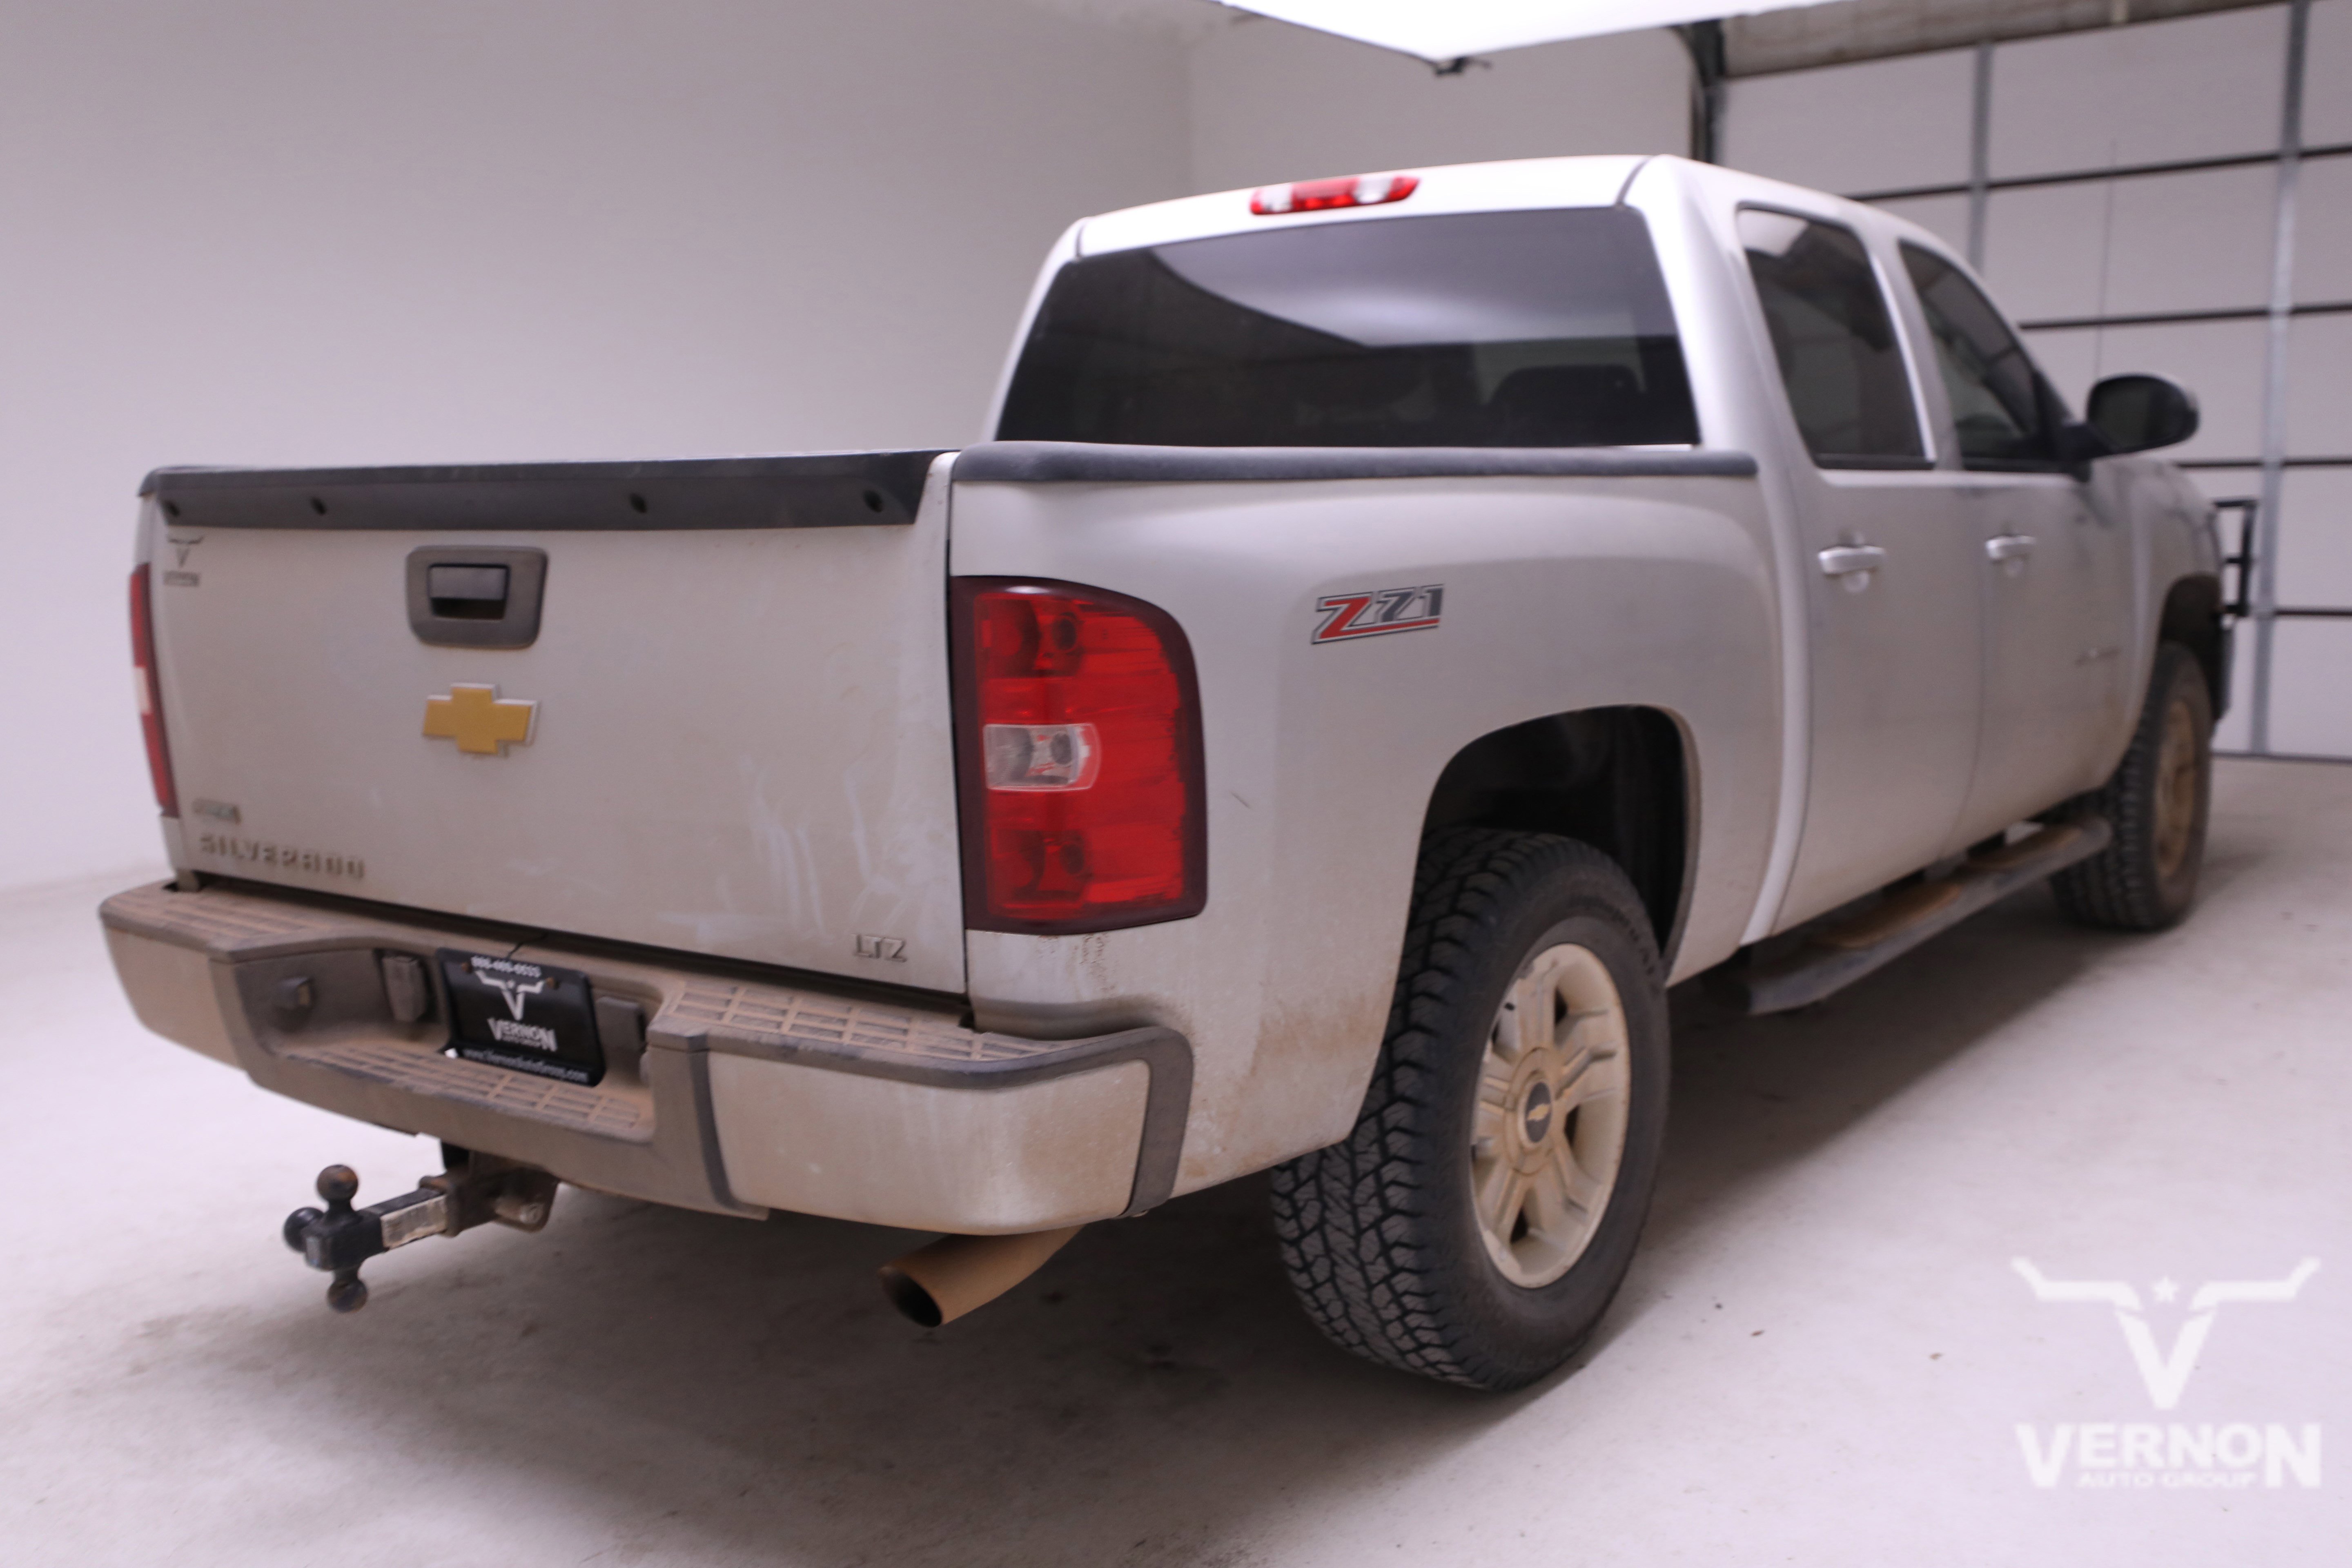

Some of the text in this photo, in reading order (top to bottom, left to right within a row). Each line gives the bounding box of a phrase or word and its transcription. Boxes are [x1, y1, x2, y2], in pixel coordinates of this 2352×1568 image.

[1311, 584, 1444, 644] Z71
[200, 833, 365, 879] SILVERADO
[853, 933, 907, 962] LTZ
[487, 1017, 558, 1051] VERNON
